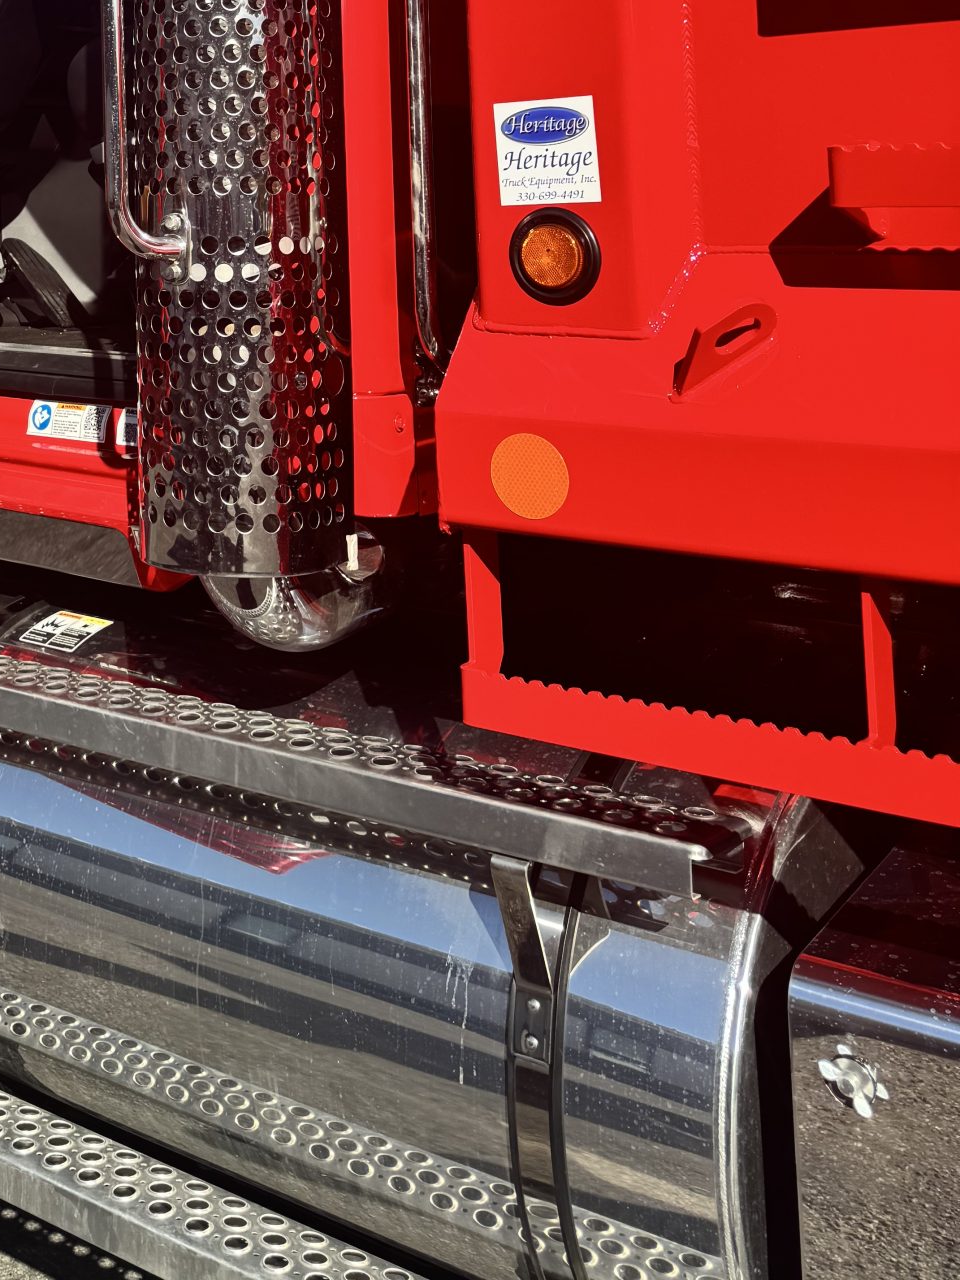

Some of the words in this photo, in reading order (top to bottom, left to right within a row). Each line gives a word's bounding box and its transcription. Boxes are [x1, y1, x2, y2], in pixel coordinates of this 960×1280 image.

[504, 111, 585, 136] Heritage
[503, 147, 593, 176] Heritage
[502, 176, 528, 188] Truck
[580, 174, 597, 184] Inc.
[516, 189, 585, 202] 330-699-4491
